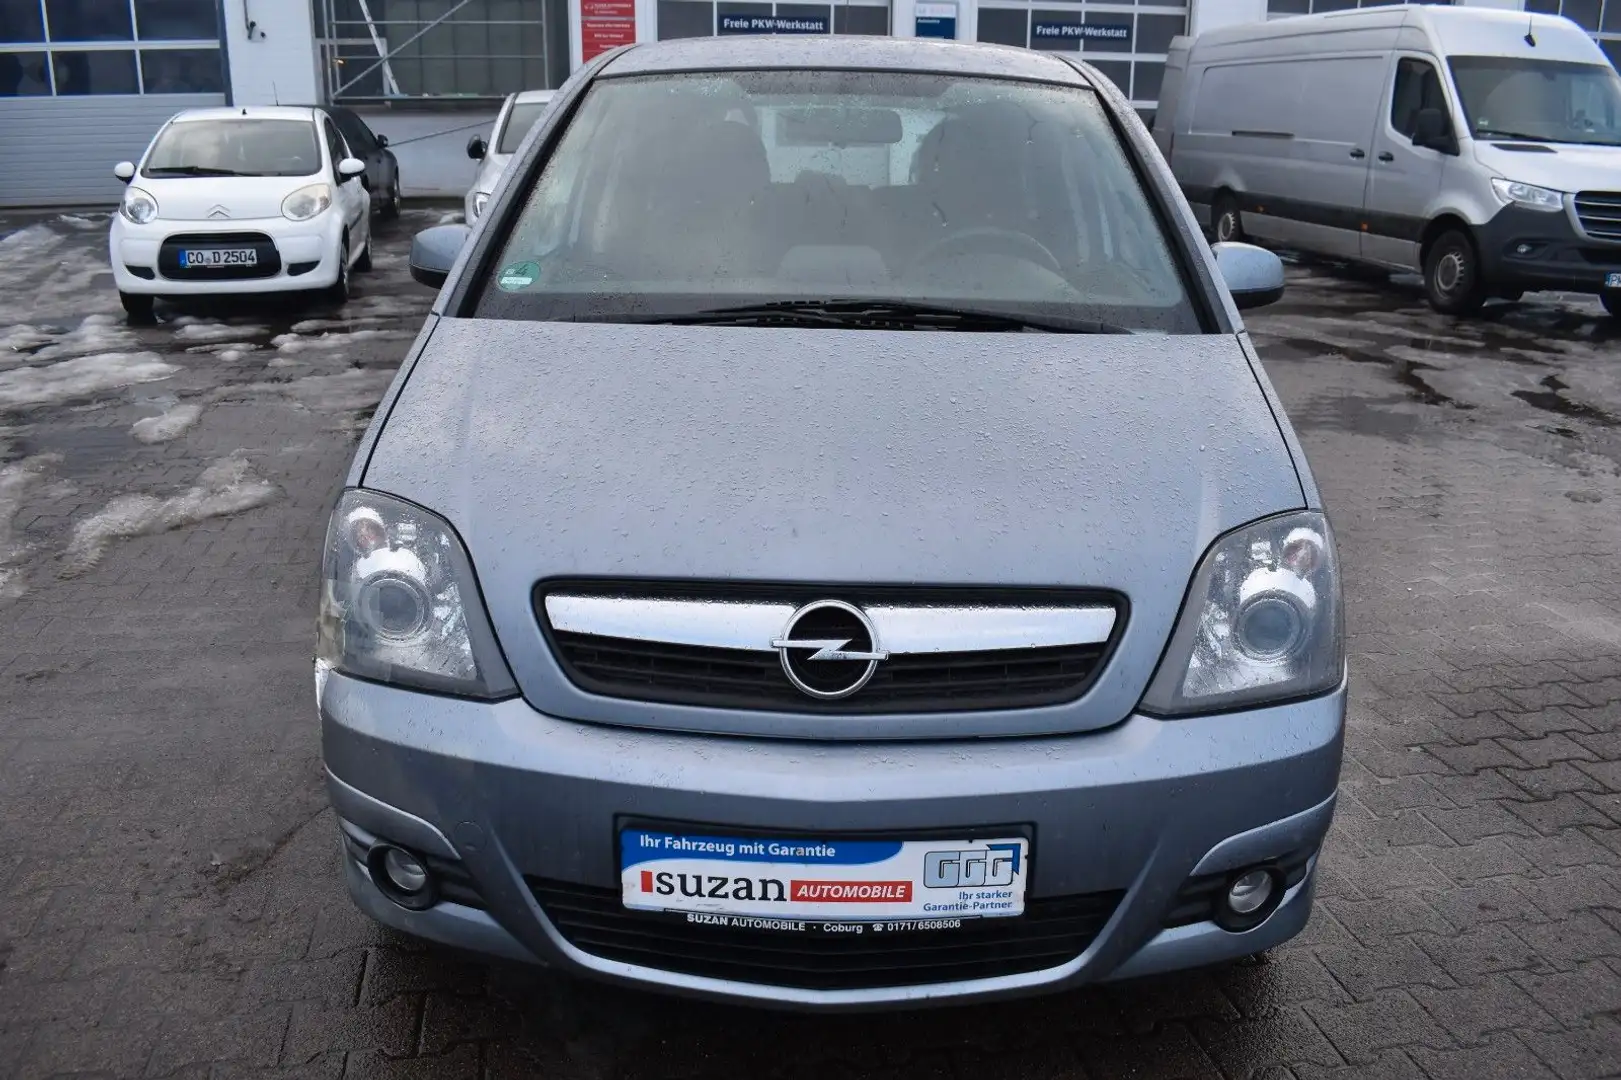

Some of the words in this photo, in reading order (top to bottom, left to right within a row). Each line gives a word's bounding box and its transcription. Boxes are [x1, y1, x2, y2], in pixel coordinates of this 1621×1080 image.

[723, 18, 749, 29] Freie
[751, 18, 824, 31] PKW-Werkstatt
[1036, 25, 1060, 36] Freie
[1061, 25, 1128, 38] PKW-Werkstatt
[223, 250, 256, 263] 2504
[640, 834, 661, 849] Ihr
[664, 836, 735, 856] Fahrzeug
[738, 841, 765, 856] mit
[768, 843, 836, 858] Garantie
[655, 871, 787, 902] suzan
[797, 884, 906, 899] AUTOMOBILE
[959, 890, 974, 900] Ihr
[976, 889, 1013, 900] starker
[923, 900, 1013, 912] Garantie-Partner
[687, 913, 728, 926] SUZAN
[731, 917, 806, 932] AUTOMOBILE
[823, 923, 864, 934] Coburg
[887, 919, 961, 931] 0171/6508506
